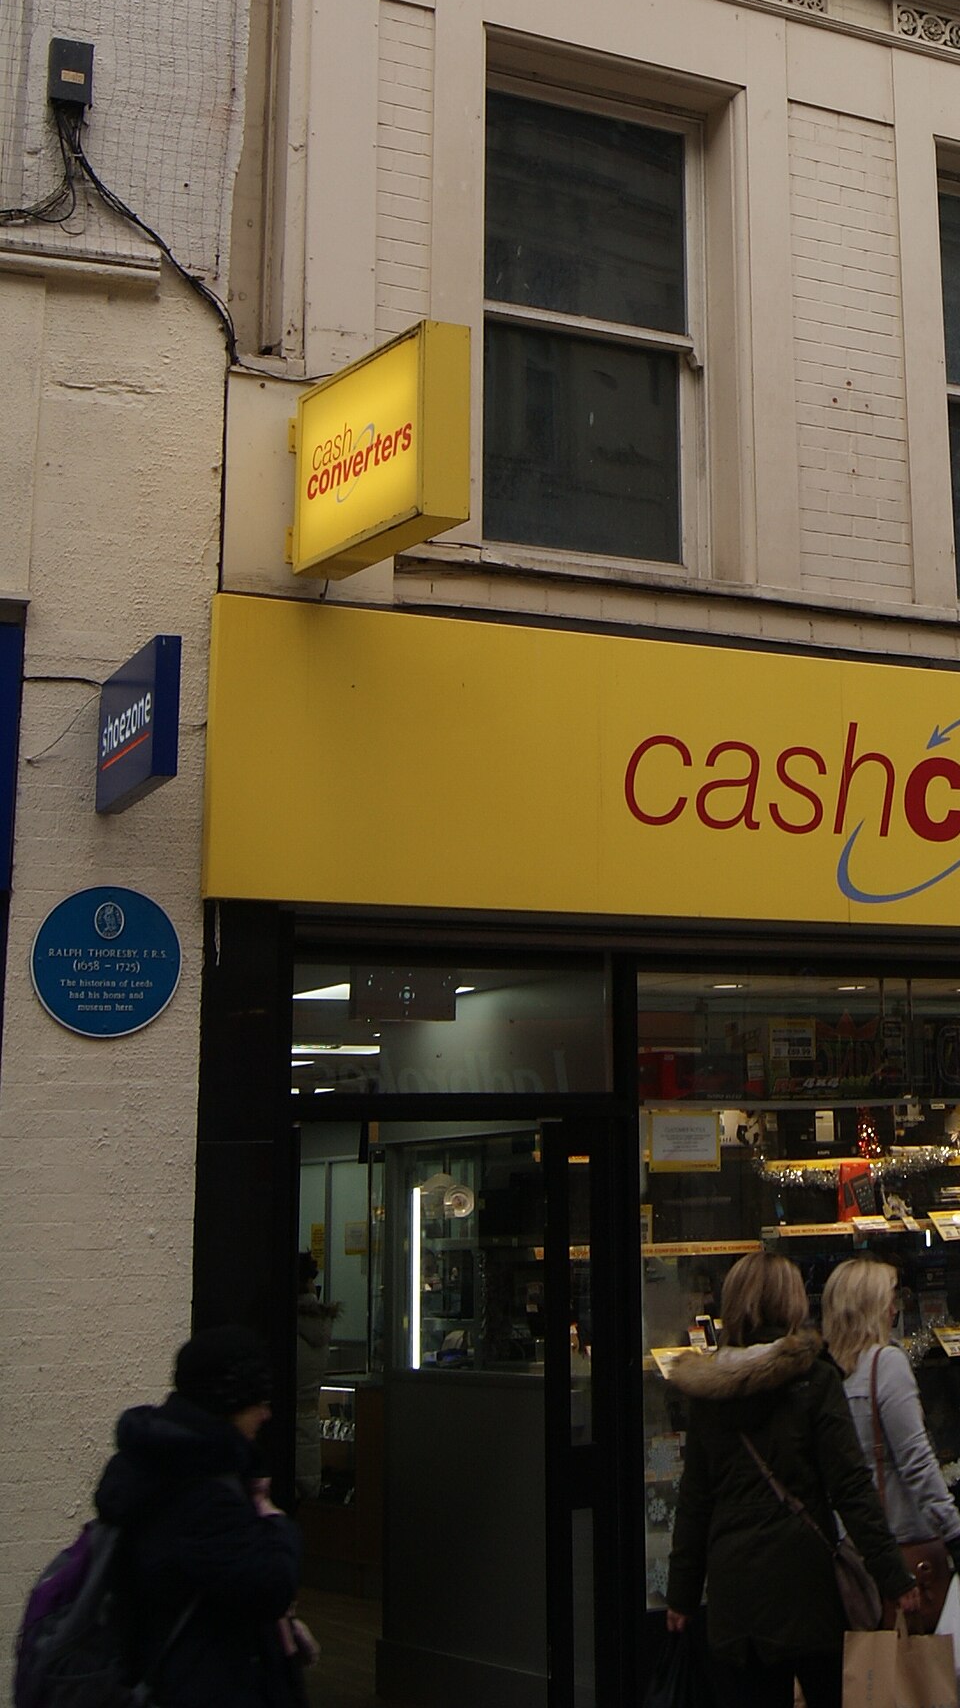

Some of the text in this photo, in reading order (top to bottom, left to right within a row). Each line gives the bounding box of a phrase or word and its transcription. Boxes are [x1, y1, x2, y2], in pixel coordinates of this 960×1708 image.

[312, 422, 353, 471] cash
[307, 422, 412, 500] converters
[102, 692, 151, 757] shoezone
[48, 948, 82, 957] RALPH
[73, 959, 100, 972] (1658
[116, 960, 141, 973] 1725)
[60, 979, 76, 987] The
[80, 979, 116, 987] historian
[119, 979, 128, 987] of
[69, 991, 144, 999] had his home and
[78, 1003, 112, 1011] museum
